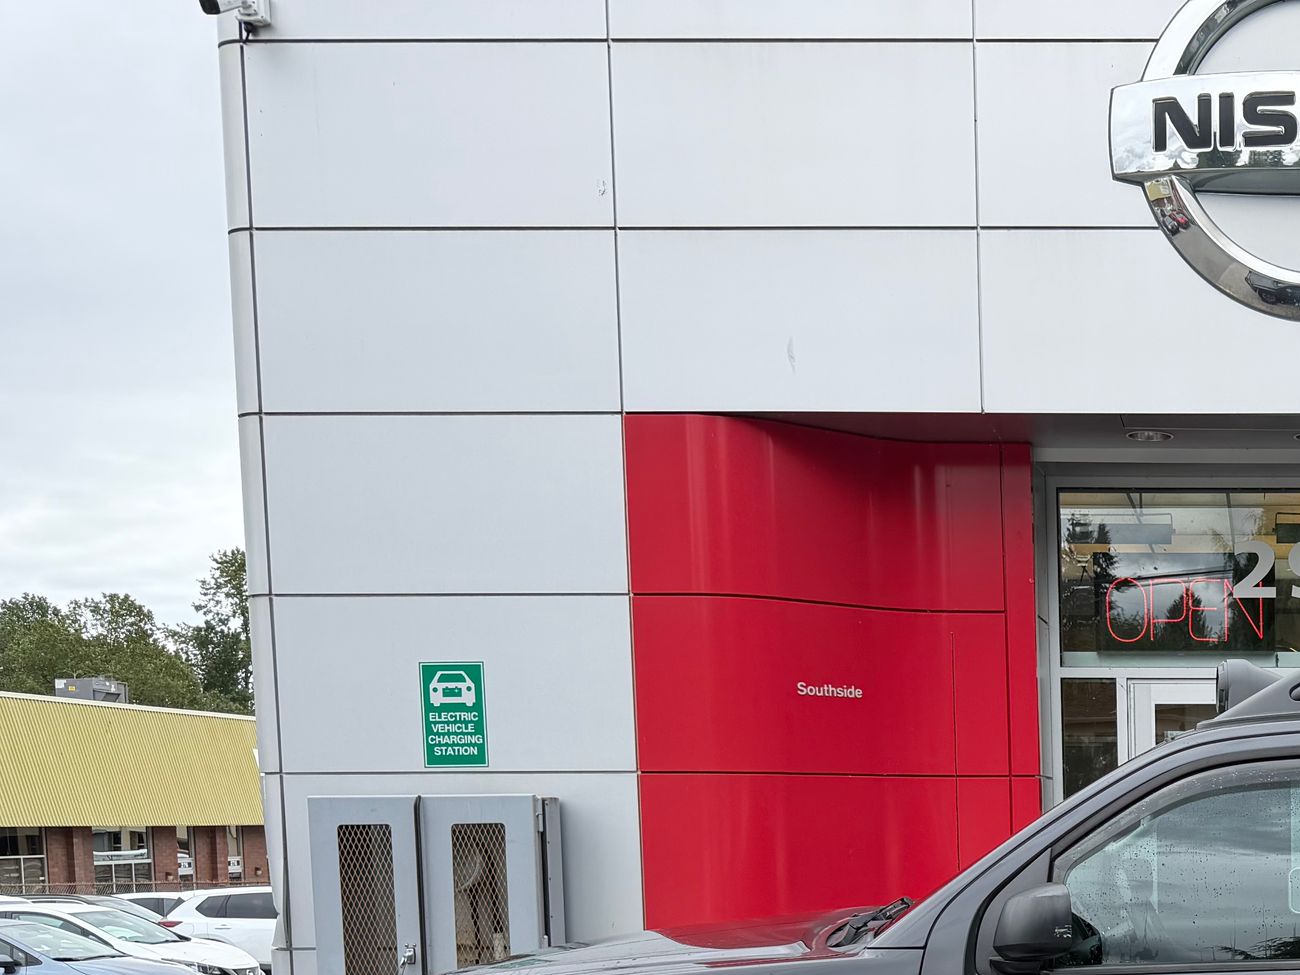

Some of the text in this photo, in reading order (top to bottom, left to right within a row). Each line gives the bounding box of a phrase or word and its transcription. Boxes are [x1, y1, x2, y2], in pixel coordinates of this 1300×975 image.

[1105, 576, 1264, 643] OPEN
[797, 681, 863, 698] Southside
[429, 712, 478, 721] ELECTRIC
[431, 723, 475, 732] VEHICLE
[428, 735, 483, 744] CHARGING
[434, 746, 478, 755] STATION
